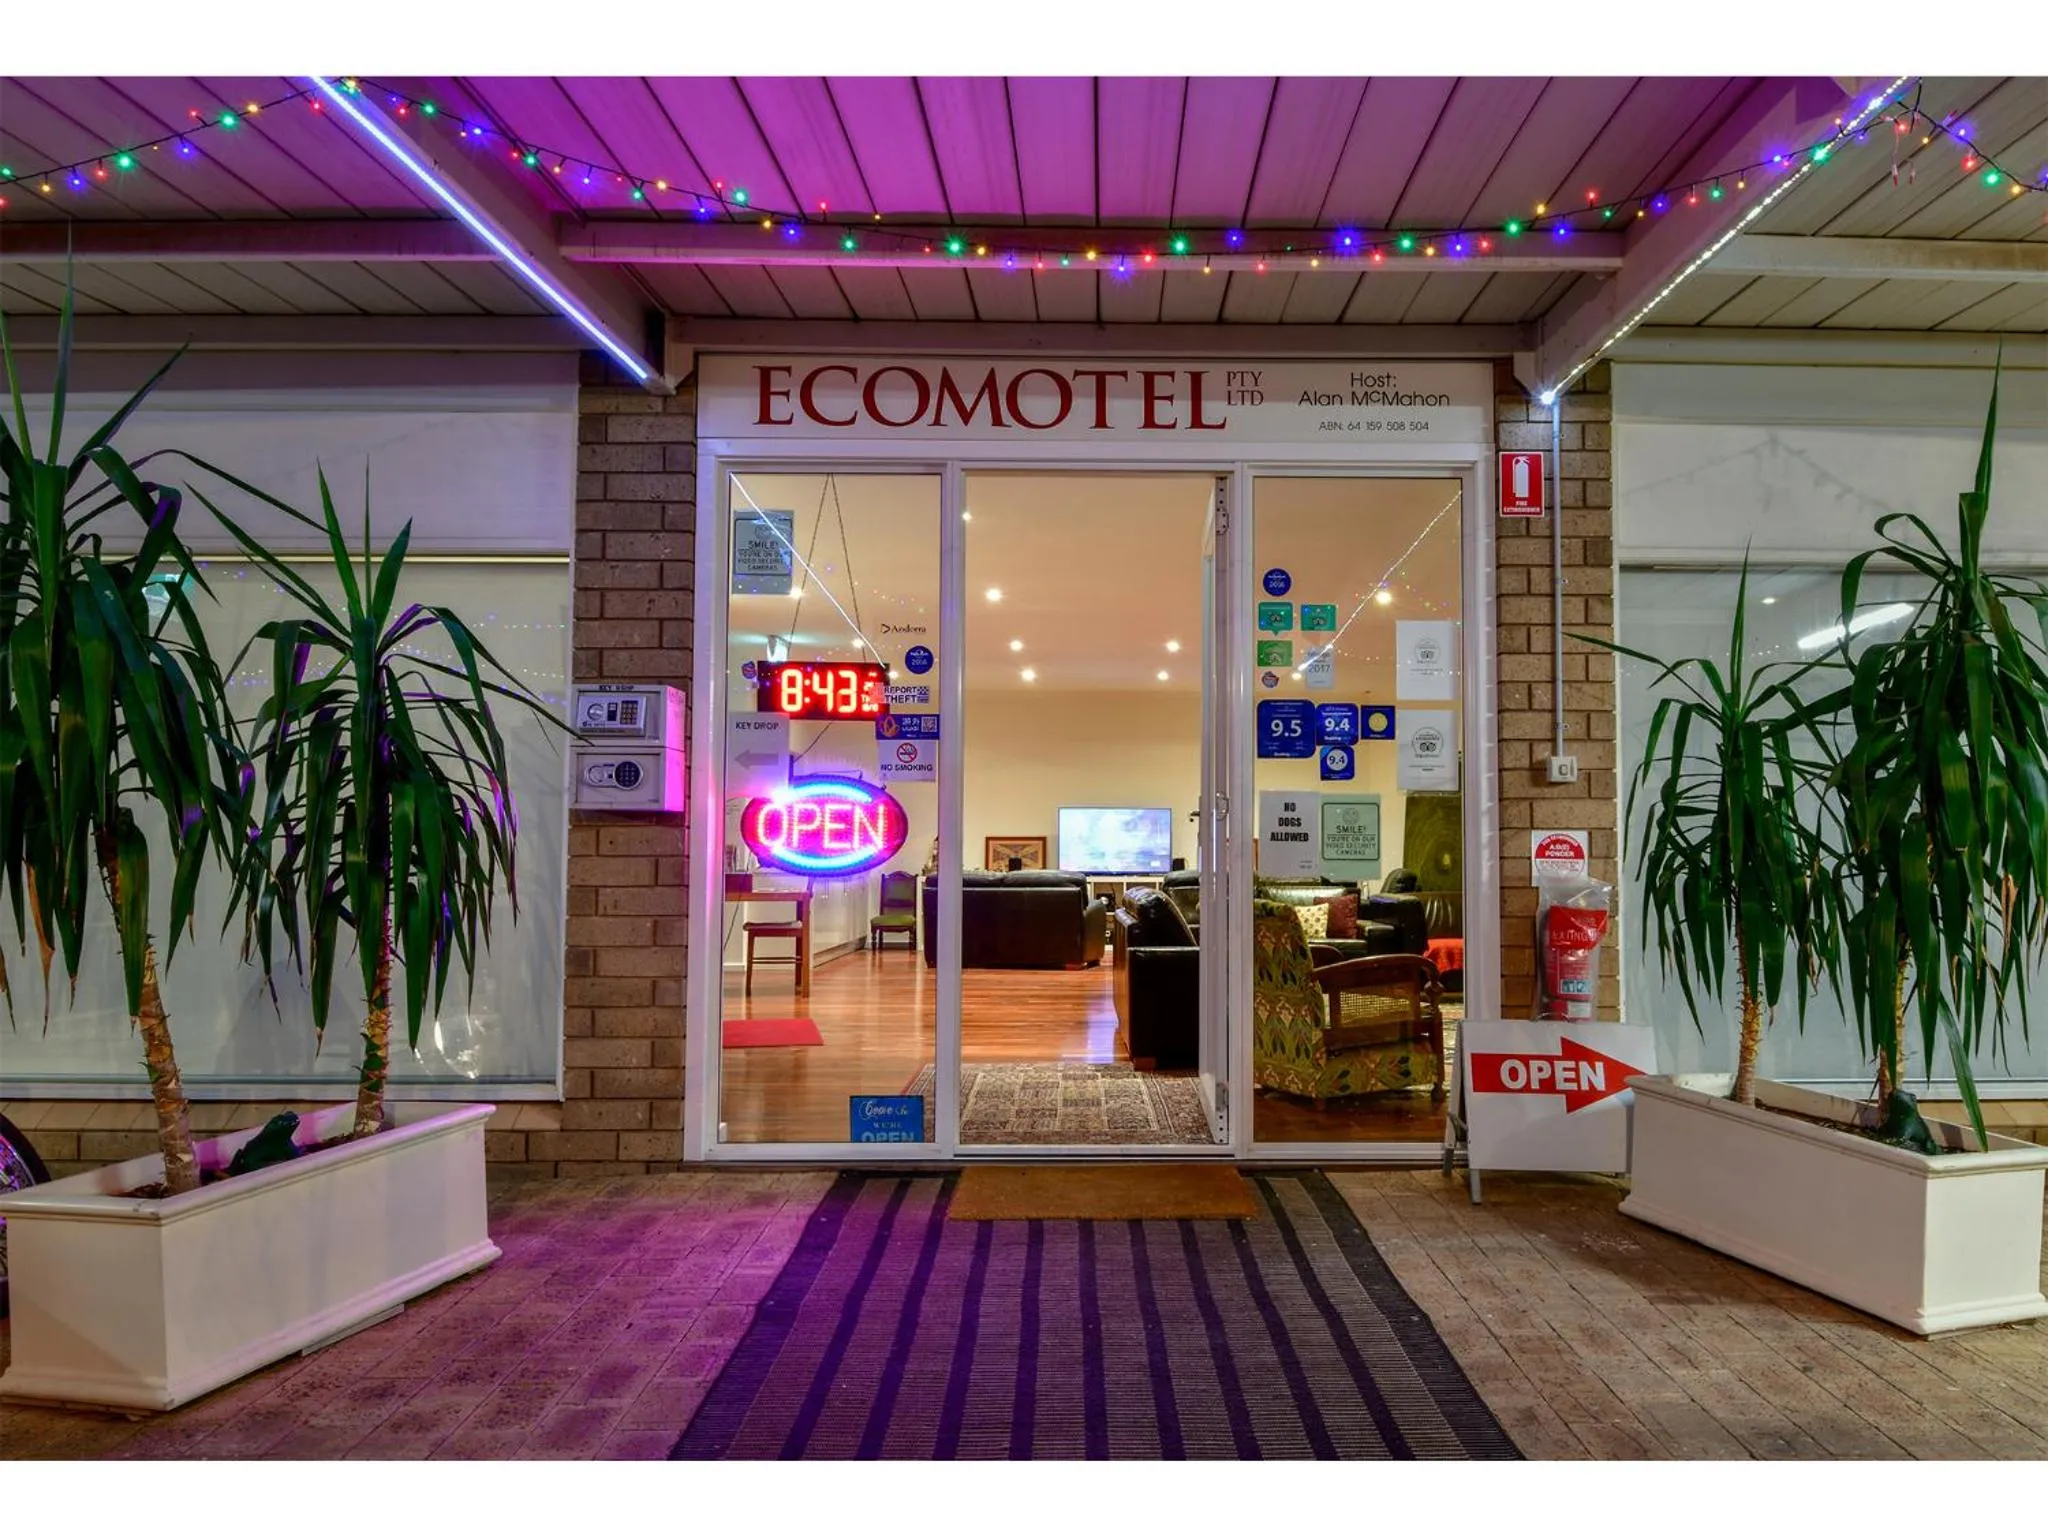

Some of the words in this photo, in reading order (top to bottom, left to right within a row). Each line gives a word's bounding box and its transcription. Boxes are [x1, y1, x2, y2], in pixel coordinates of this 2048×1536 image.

[1226, 371, 1263, 387] PTY
[1351, 372, 1397, 388] Host:
[752, 365, 1227, 429] ECOMOTEL
[1226, 390, 1264, 406] LTD
[1298, 390, 1343, 406] Alan
[1351, 390, 1450, 407] McMahon
[1318, 421, 1344, 431] ABN:
[1347, 421, 1361, 431] 64
[1366, 421, 1382, 431] 159
[1386, 421, 1406, 431] 508
[1410, 421, 1429, 431] 504
[781, 668, 857, 713] 8:43
[885, 686, 917, 694] REPORT
[885, 694, 917, 704] THEFT
[735, 721, 751, 730] KEY
[753, 721, 779, 730] DROP
[1270, 719, 1303, 738] 9.5
[1324, 717, 1351, 732] 9.4
[1328, 755, 1346, 765] 9.4
[880, 764, 893, 772] NO
[895, 764, 933, 772] SMOKING
[1284, 802, 1297, 813] NO
[757, 800, 886, 852] OPEN
[1278, 817, 1302, 828] DOGS
[1270, 832, 1309, 842] ALLOWED
[1500, 1058, 1606, 1092] OPEN
